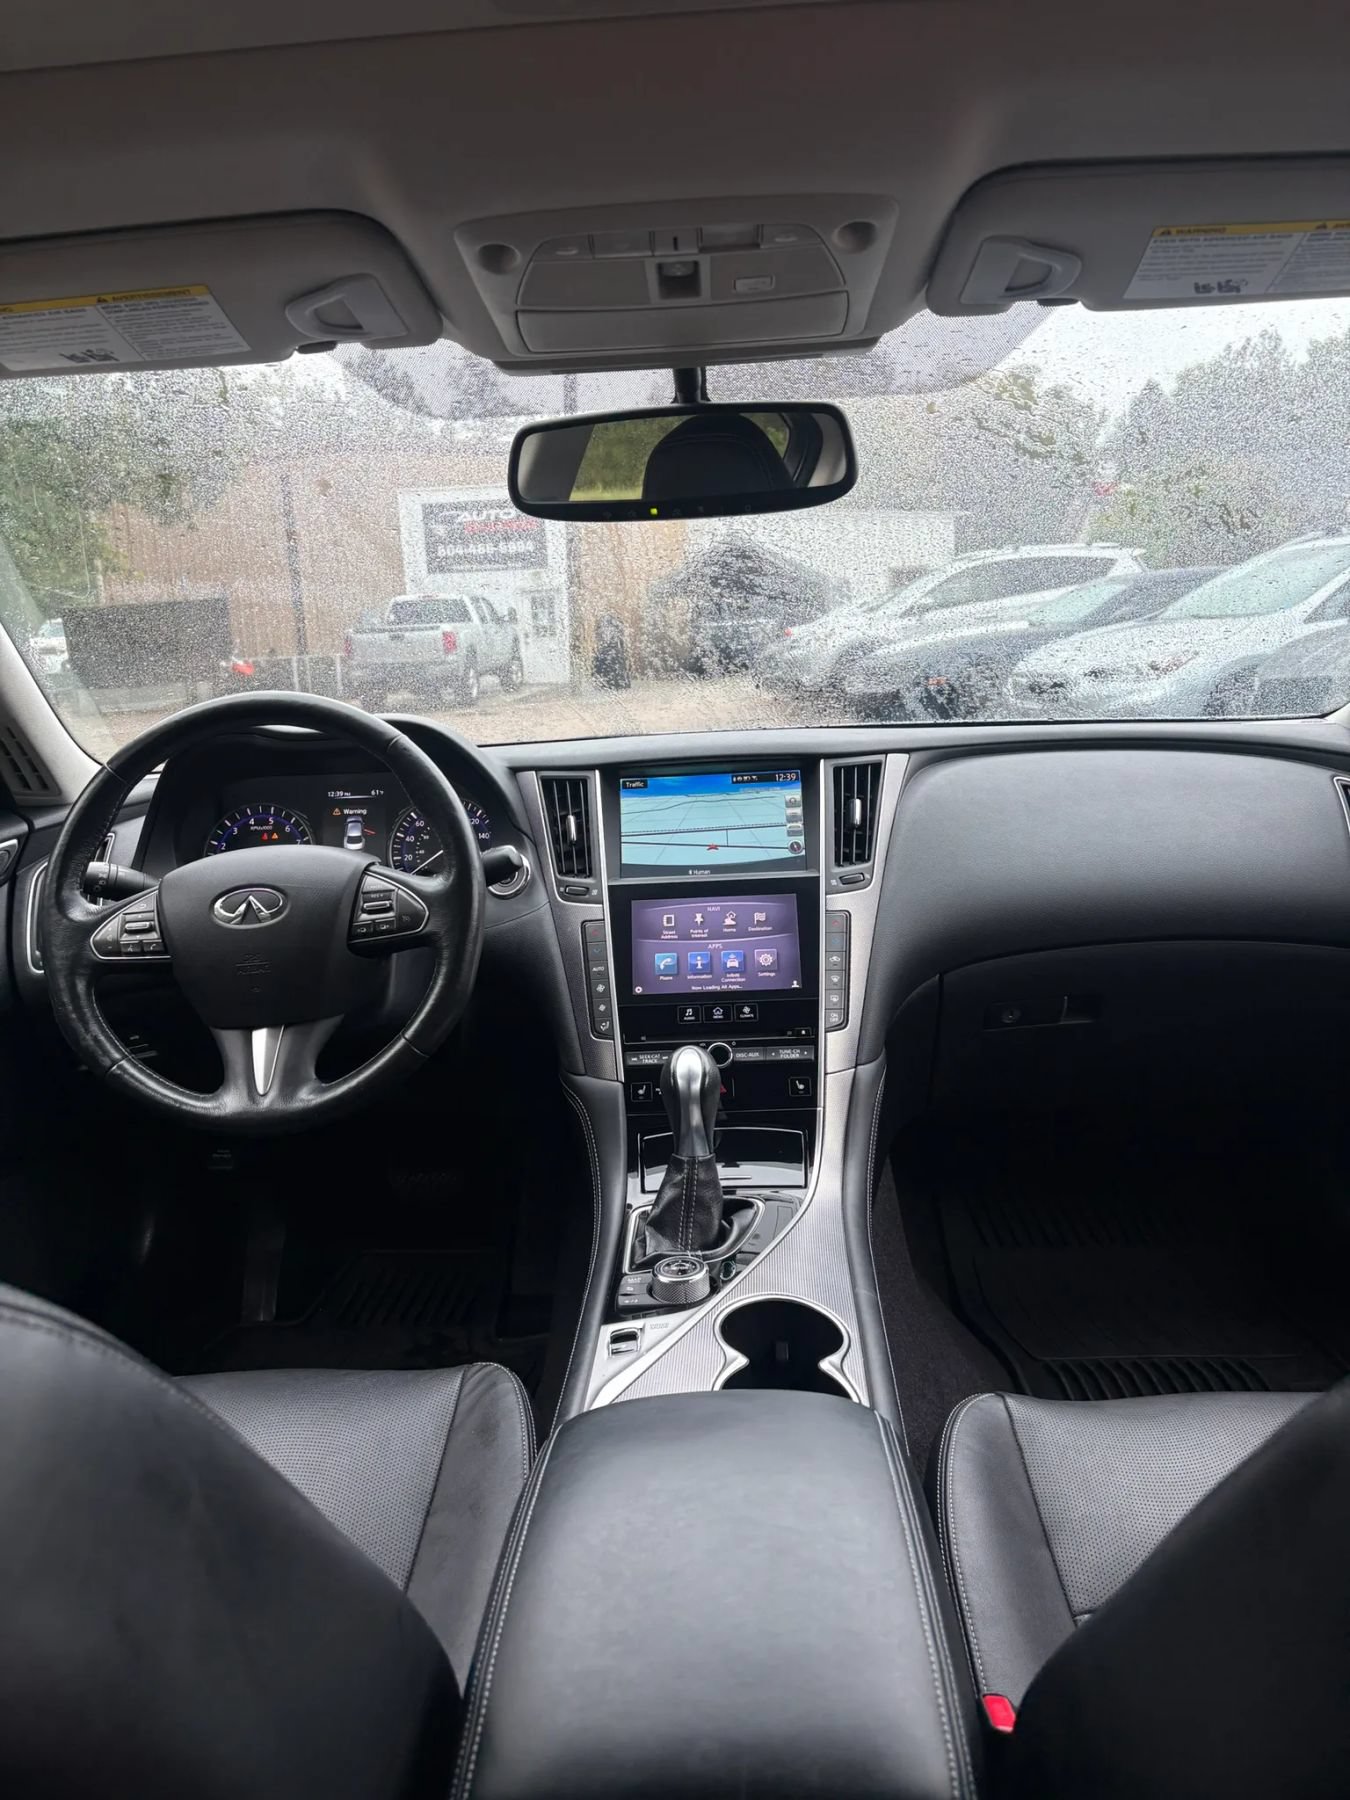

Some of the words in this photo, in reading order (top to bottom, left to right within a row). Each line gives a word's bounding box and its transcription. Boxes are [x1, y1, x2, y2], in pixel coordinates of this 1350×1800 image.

[775, 773, 797, 782] 12:39
[268, 817, 274, 825] 5
[415, 820, 425, 828] 60
[232, 827, 239, 835] 3
[284, 825, 291, 833] 6
[405, 835, 415, 843] 40
[478, 832, 491, 840] 140
[220, 842, 227, 850] 2
[403, 854, 413, 862] 20
